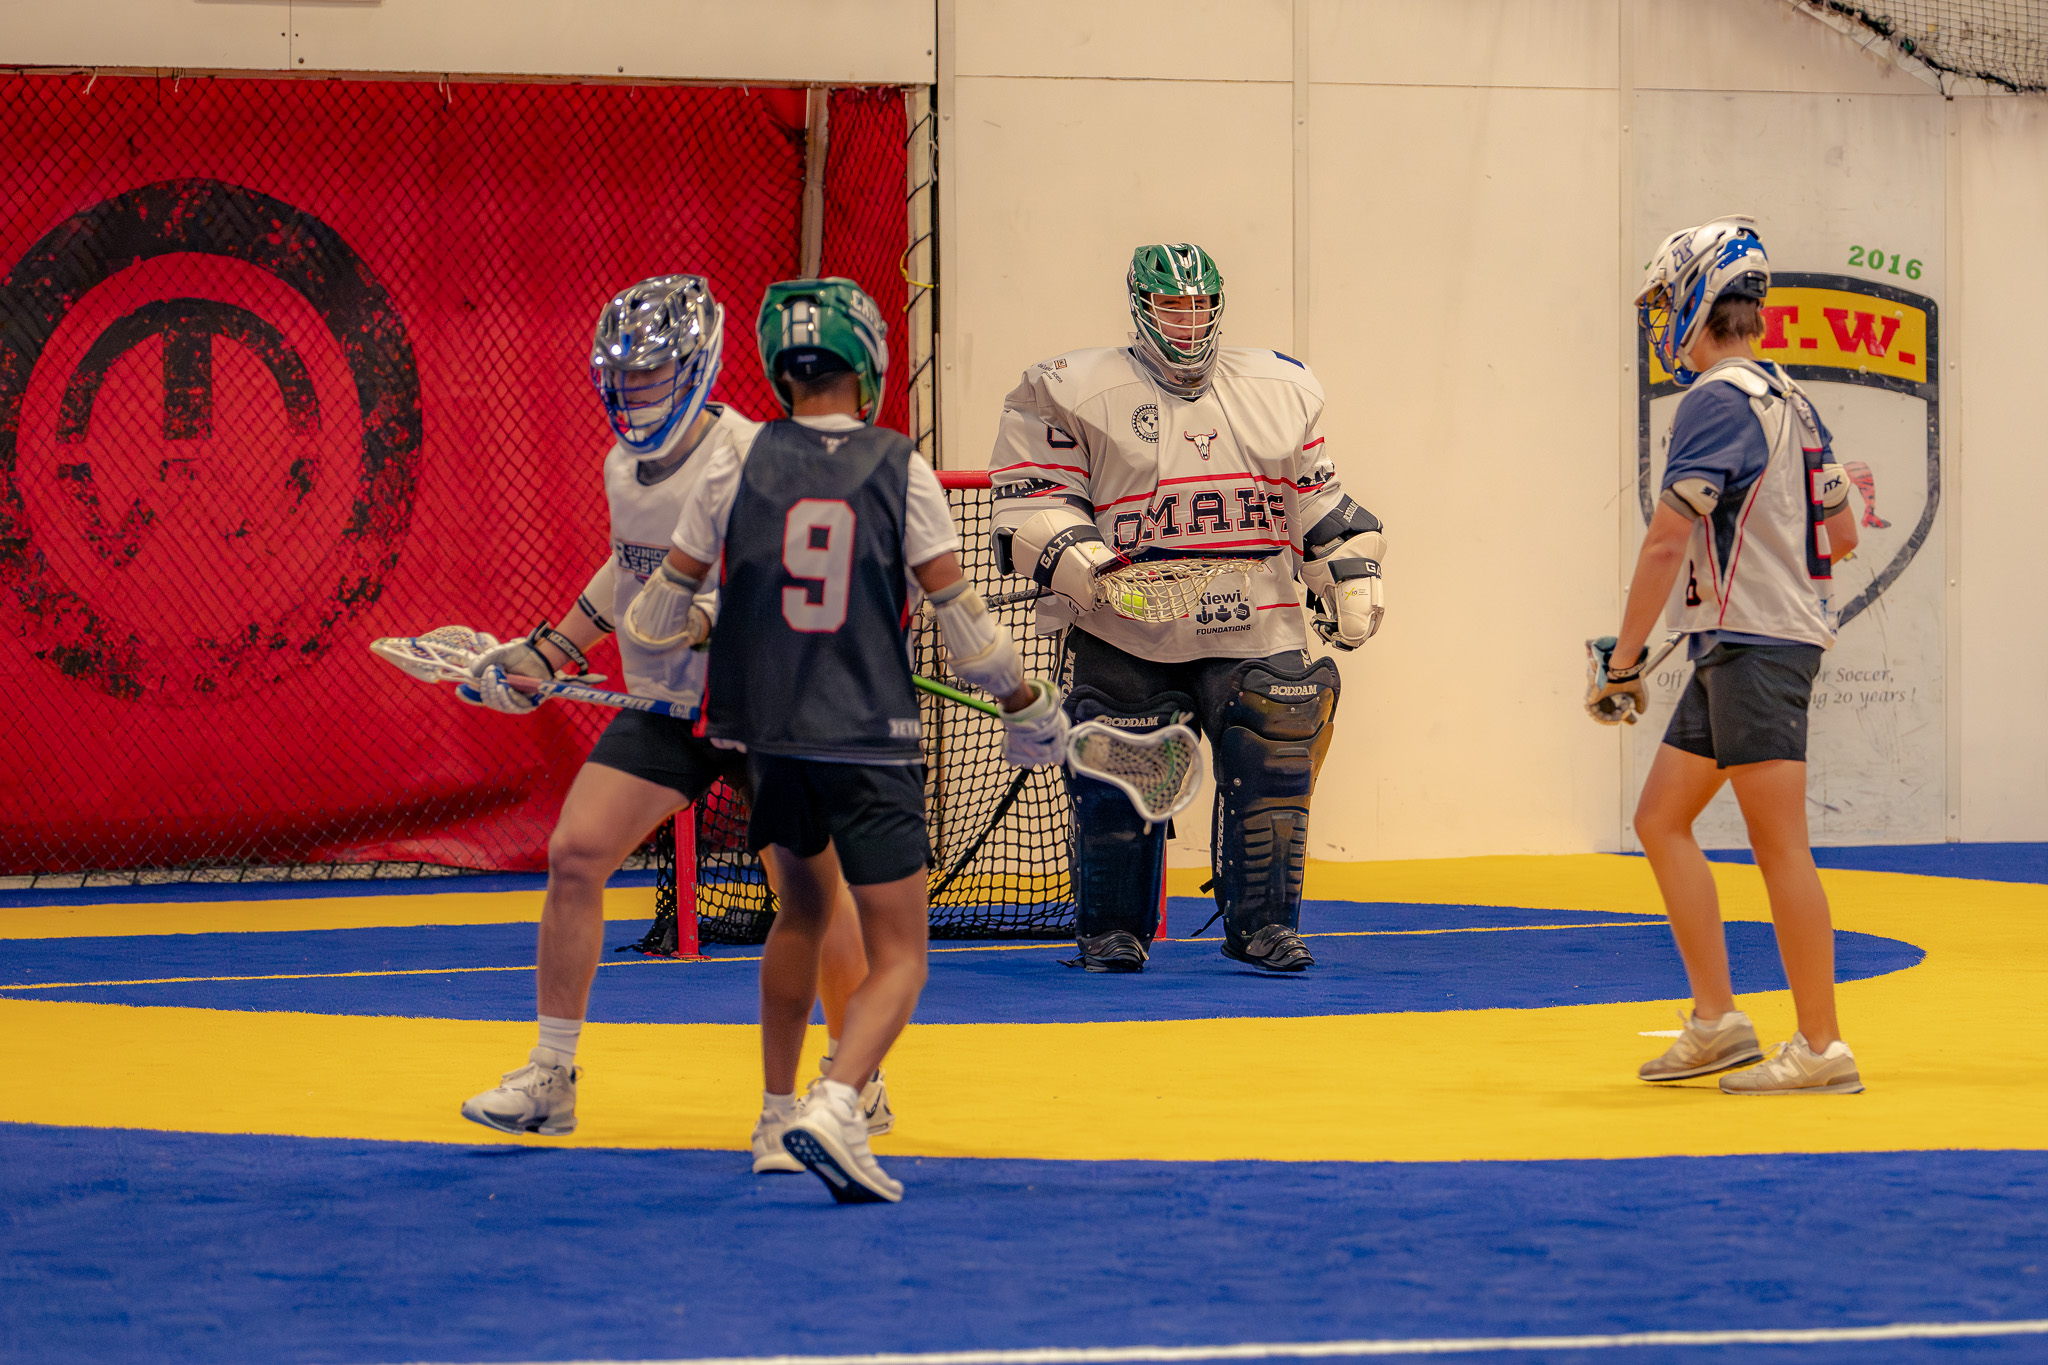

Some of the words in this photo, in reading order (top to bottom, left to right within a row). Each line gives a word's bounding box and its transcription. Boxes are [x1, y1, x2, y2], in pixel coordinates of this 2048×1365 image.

[1848, 245, 1924, 280] 2016
[1040, 529, 1074, 569] GAIT
[782, 497, 857, 634] 9
[1196, 624, 1251, 636] FOUNDATIONS
[1836, 667, 1894, 684] Soccer,
[1269, 685, 1318, 697] BODDAM
[1832, 692, 1854, 705] 20
[1859, 688, 1906, 709] years
[1104, 716, 1159, 728] BODDAM
